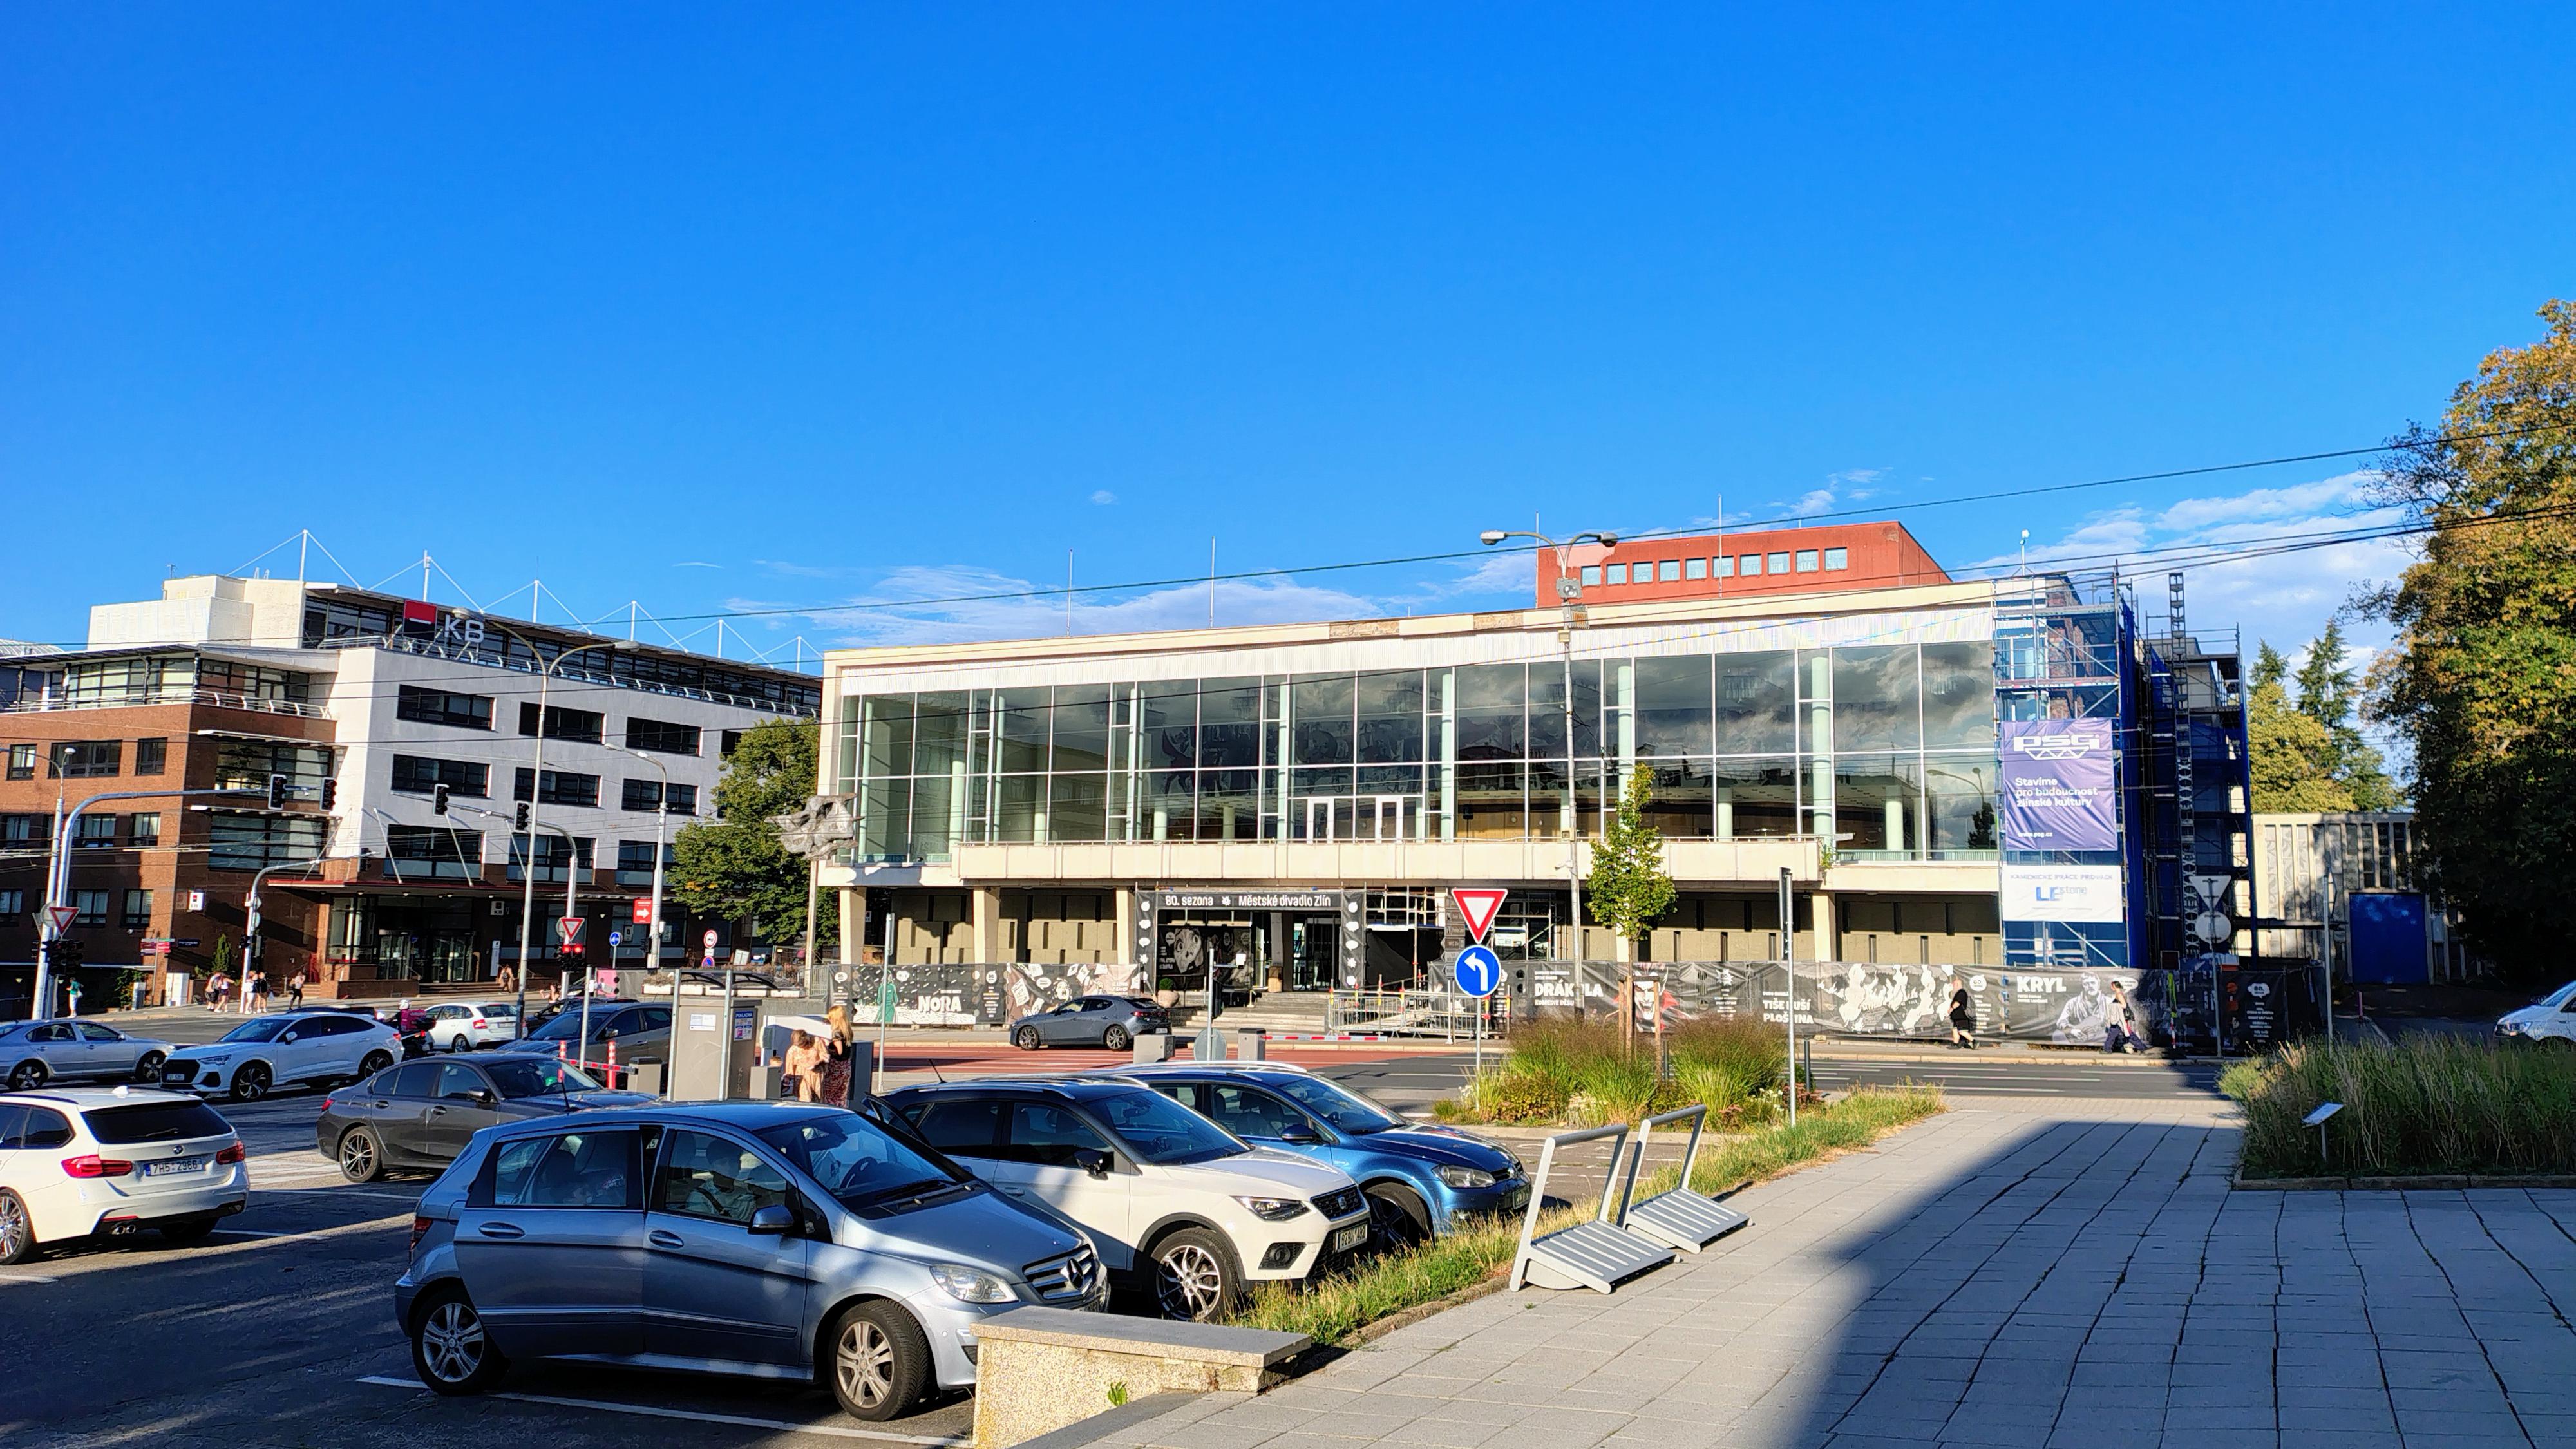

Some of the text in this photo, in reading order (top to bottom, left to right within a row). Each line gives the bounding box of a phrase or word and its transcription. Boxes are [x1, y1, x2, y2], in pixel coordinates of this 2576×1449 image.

[444, 614, 484, 643] KB
[2015, 777, 2058, 786] Stavíme
[2016, 787, 2098, 799] pro budoucnost
[2054, 797, 2092, 807] kultury
[1165, 894, 1331, 907] 80. sezona Městské divadlo Zlín
[1535, 978, 1604, 998] DRÁKLA
[2016, 976, 2067, 993] KRYL
[918, 995, 963, 1013] NORA
[1763, 998, 1785, 1010] TIŠE
[1763, 1011, 1814, 1024] PLOŠINA
[153, 1163, 170, 1173] 7H5
